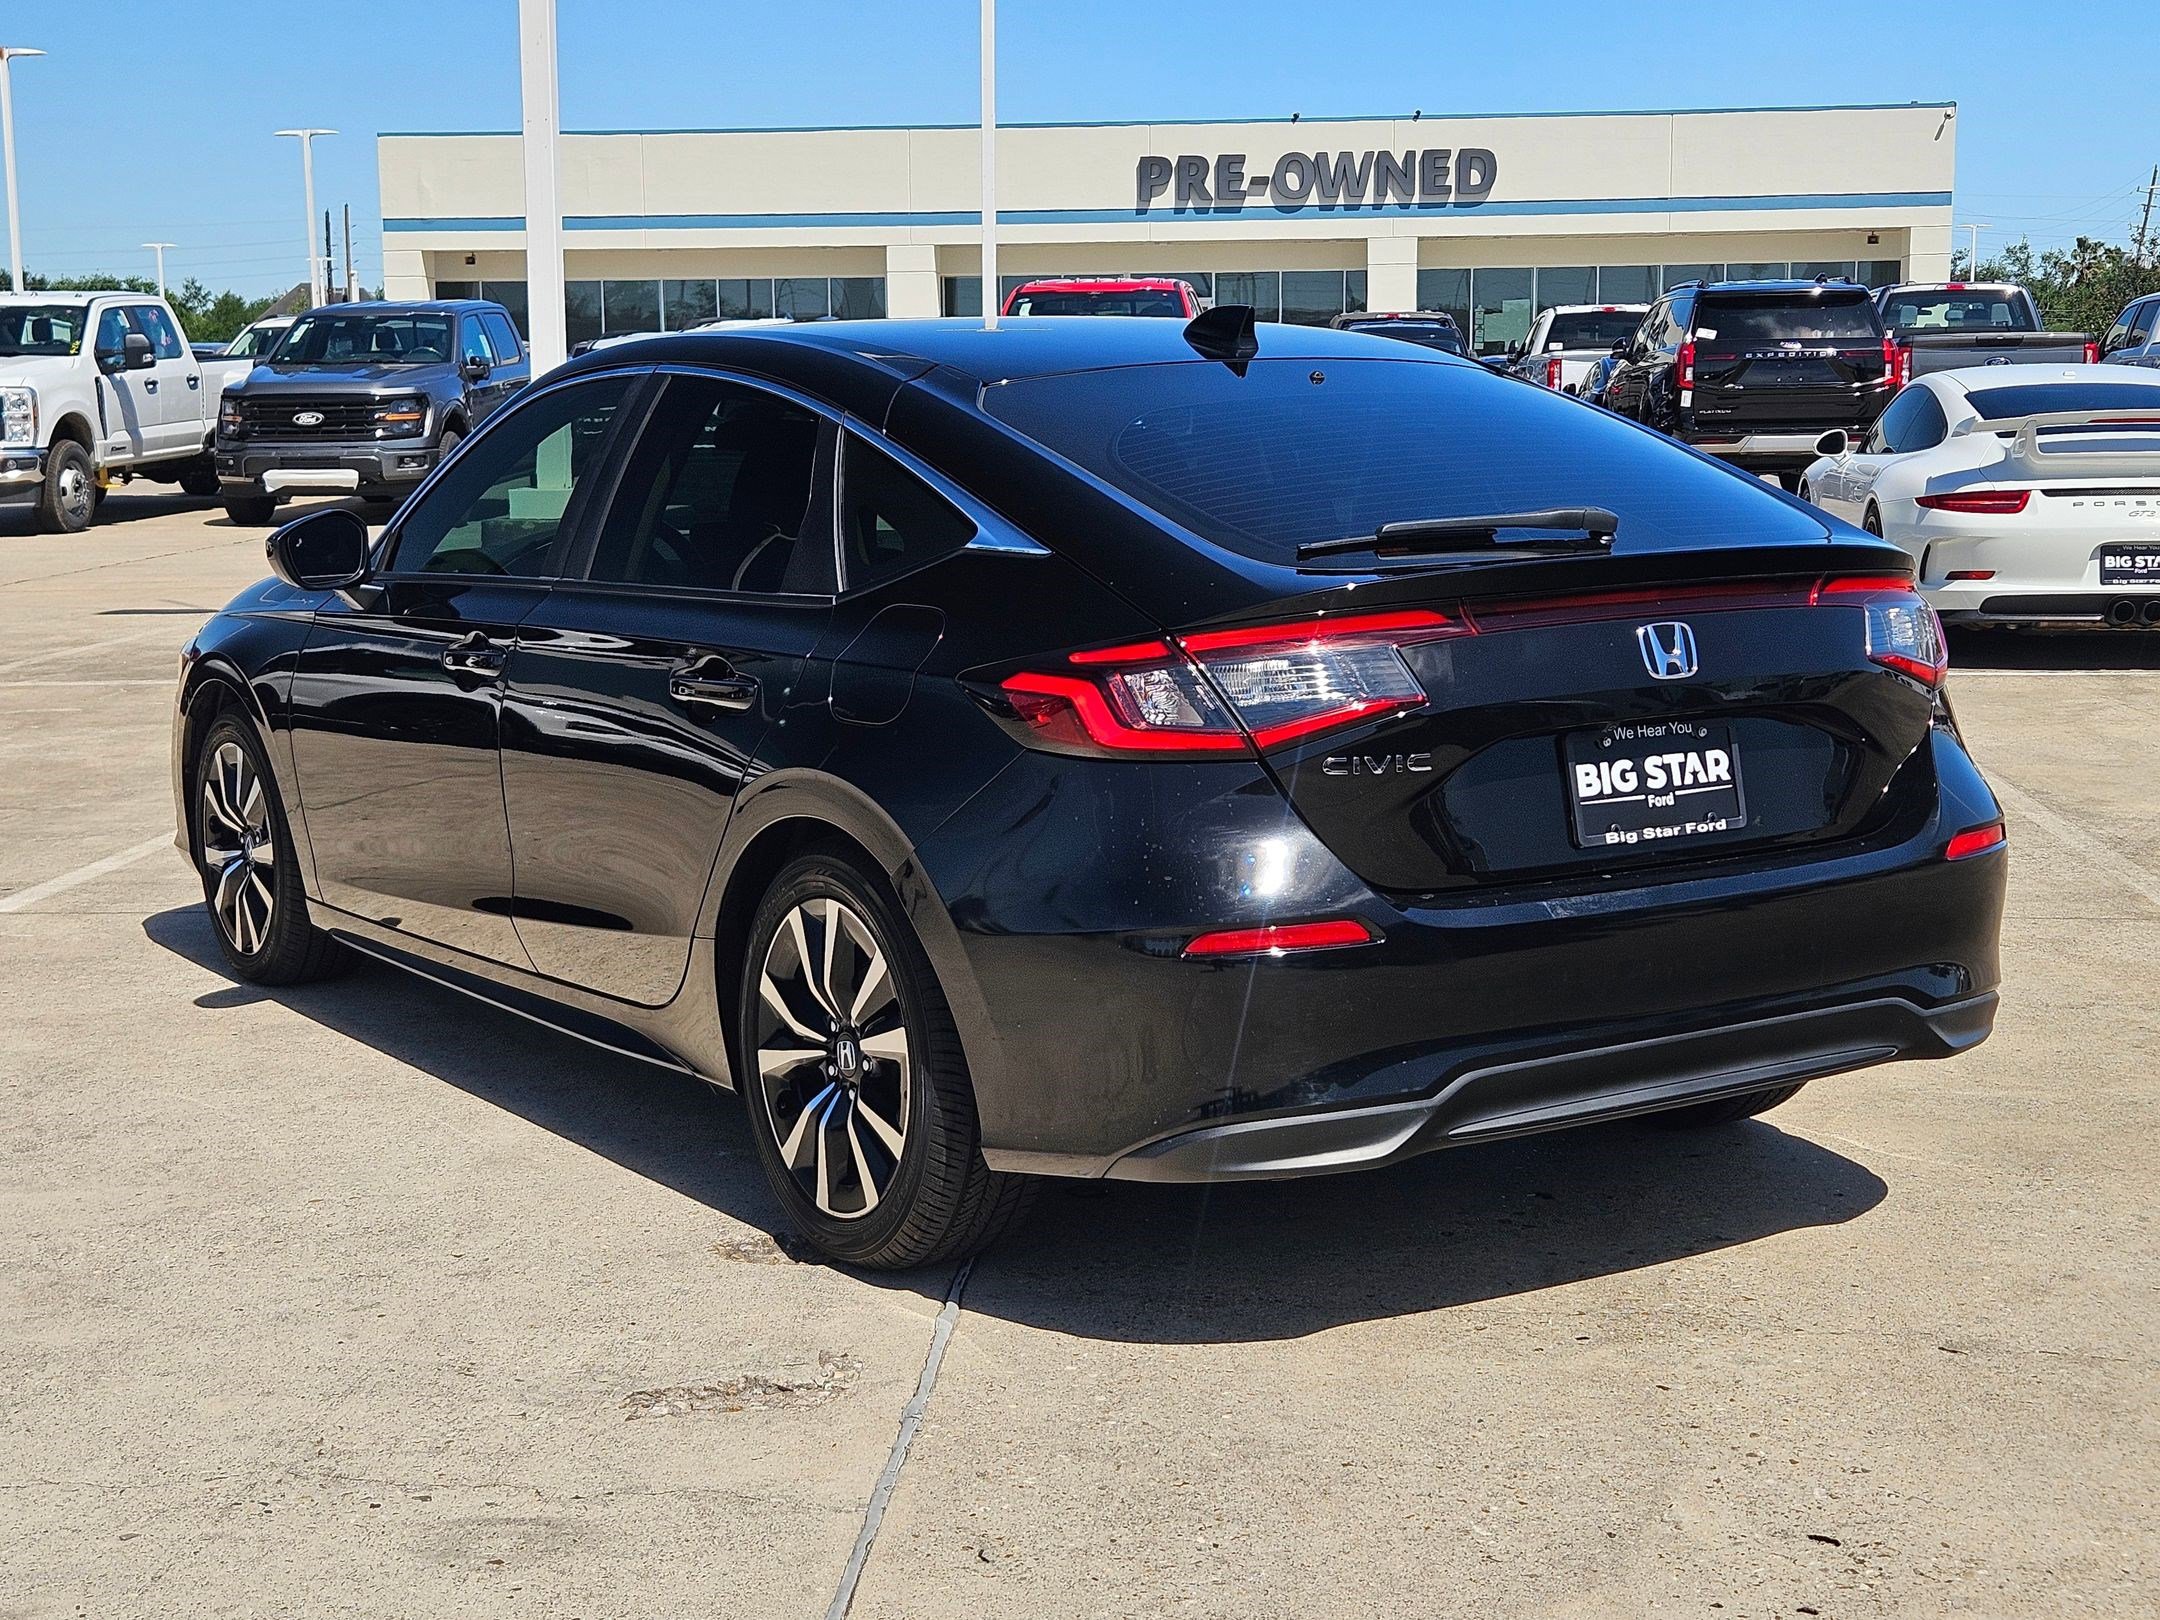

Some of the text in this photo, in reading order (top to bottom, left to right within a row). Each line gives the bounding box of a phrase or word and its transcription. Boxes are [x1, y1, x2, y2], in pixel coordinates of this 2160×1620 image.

[1137, 148, 1498, 203] PRE-OWNED
[1745, 350, 1837, 359] EXPEDITION
[2104, 555, 2132, 568] BIG
[1613, 721, 1693, 741] We Hear You
[1322, 753, 1432, 775] CIVIC
[1575, 749, 1732, 798] BIG STAR
[1647, 792, 1675, 808] Ford
[1605, 819, 1727, 845] Big Star Ford
